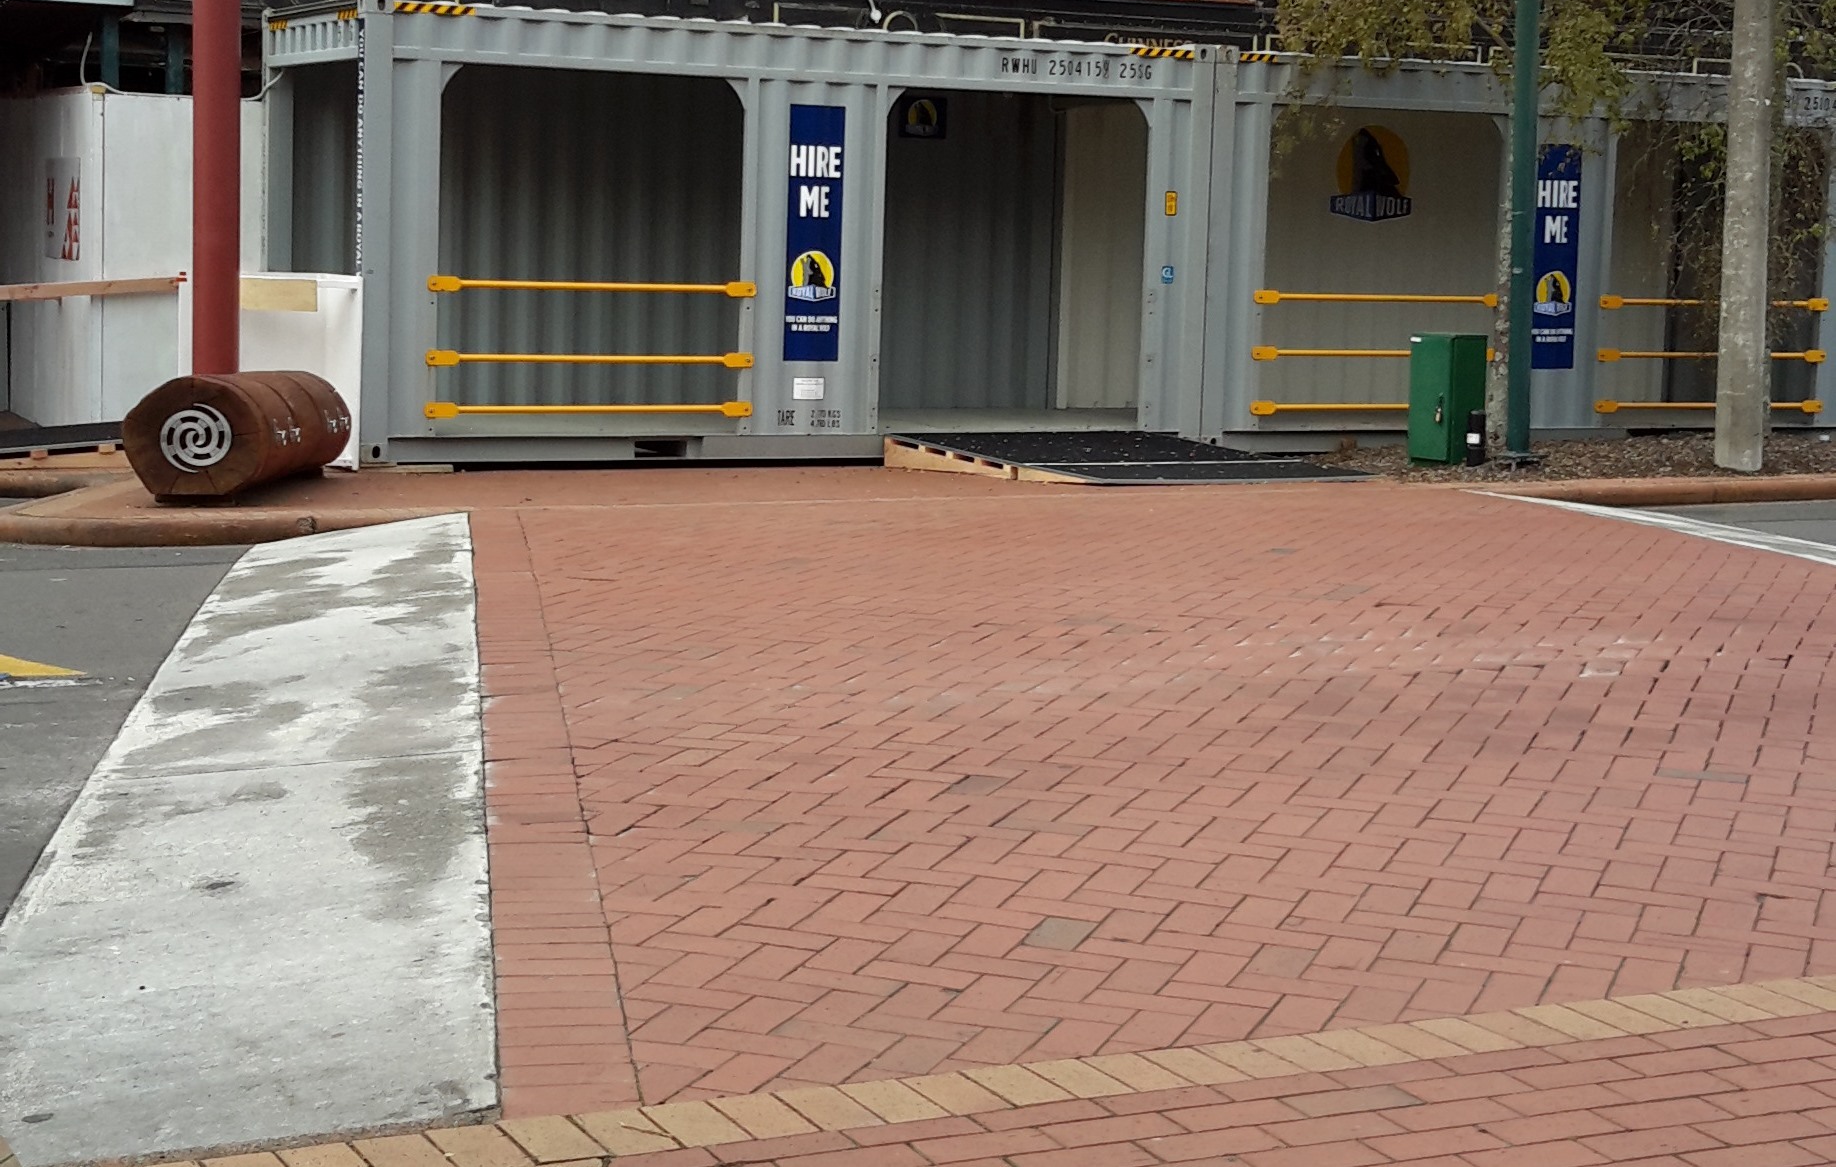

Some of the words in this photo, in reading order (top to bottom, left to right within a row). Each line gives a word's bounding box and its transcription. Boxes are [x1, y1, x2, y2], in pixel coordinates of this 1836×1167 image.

[1002, 57, 1037, 74] RWHU
[789, 144, 842, 179] HIRE
[799, 185, 830, 218] ME
[1537, 180, 1579, 208] HIRE
[1544, 216, 1568, 244] ME
